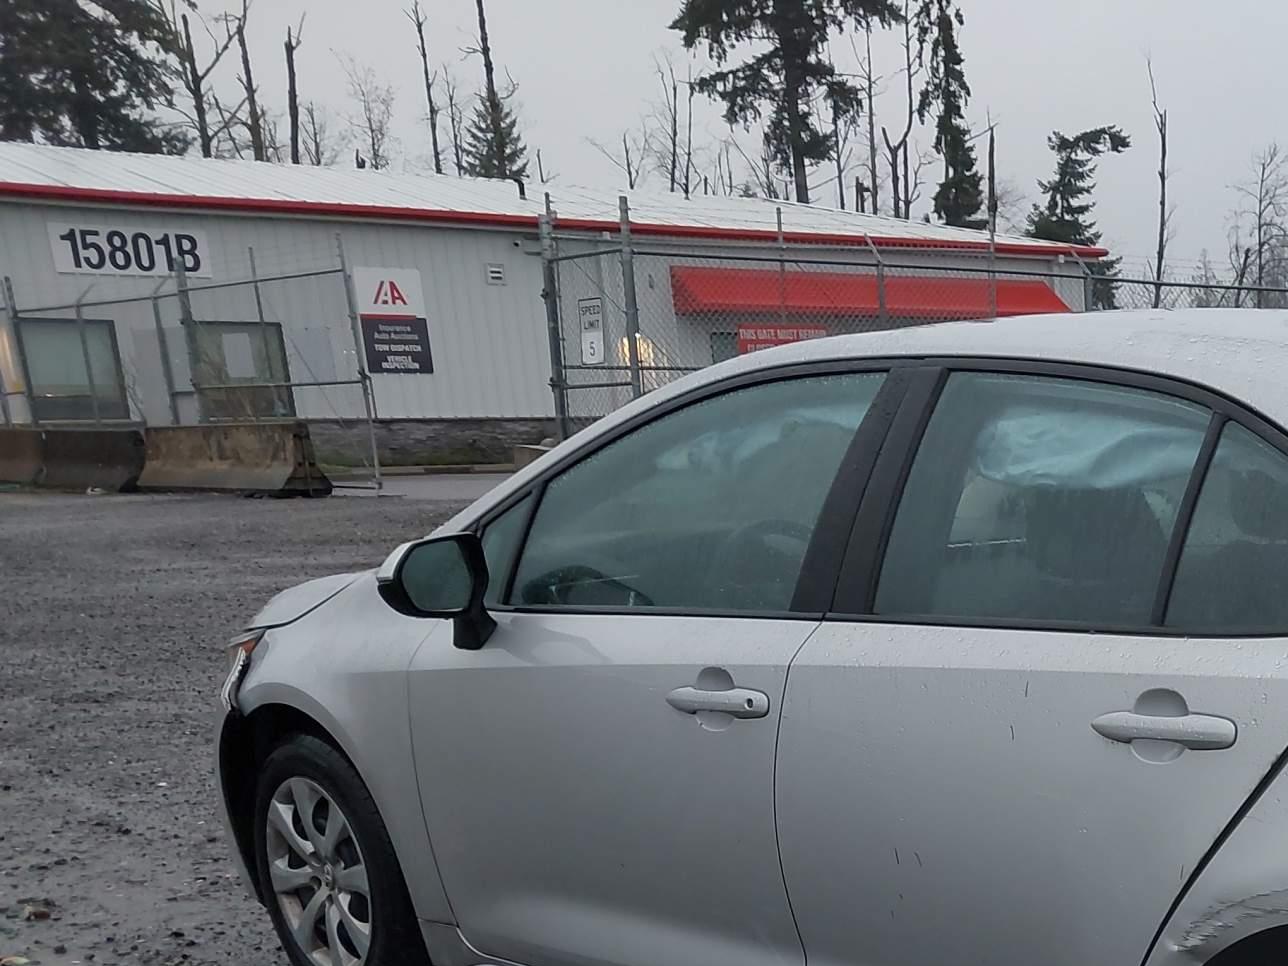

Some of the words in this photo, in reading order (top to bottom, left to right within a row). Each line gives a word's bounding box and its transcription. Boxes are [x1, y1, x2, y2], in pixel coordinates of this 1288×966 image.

[59, 228, 201, 272] 15801B
[581, 304, 601, 316] SPEED
[583, 320, 600, 330] LIMIT
[739, 328, 756, 340] THIS
[757, 328, 776, 340] GATE
[589, 341, 596, 357] 5
